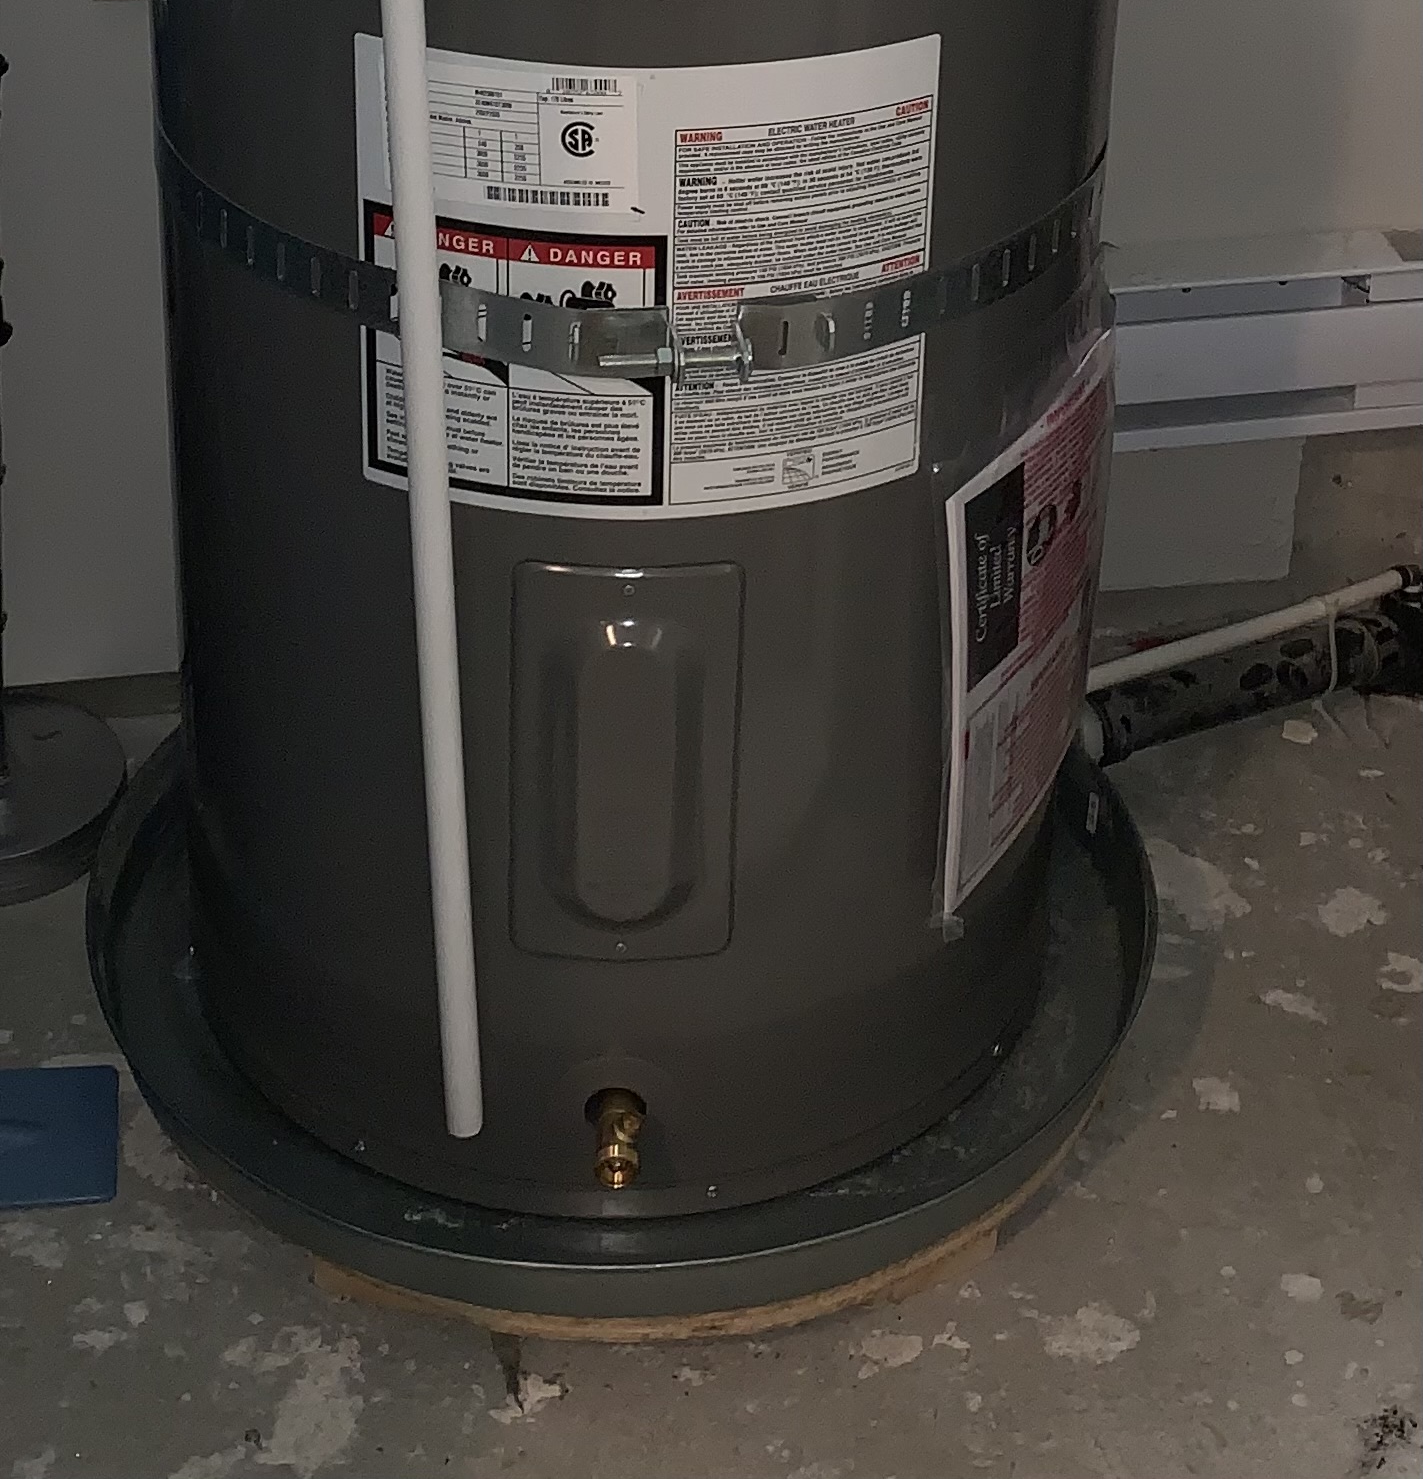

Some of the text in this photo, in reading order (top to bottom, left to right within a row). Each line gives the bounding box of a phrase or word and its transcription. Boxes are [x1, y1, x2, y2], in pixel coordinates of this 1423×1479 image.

[896, 100, 929, 116] CAUTION
[768, 117, 855, 136] ELECTRIC WATER HEATER
[680, 131, 722, 143] WARNING
[679, 176, 717, 187] WARNING
[678, 219, 710, 228] CAUTION
[439, 233, 495, 254] NGER
[550, 248, 642, 265] DANGER
[881, 255, 920, 273] ATTENTION
[677, 287, 744, 300] AVERTISSEMENT
[770, 282, 801, 293] CHAUFFE
[804, 280, 818, 288] EAU
[681, 334, 731, 345] VERTISSEMEN
[975, 533, 990, 551] of
